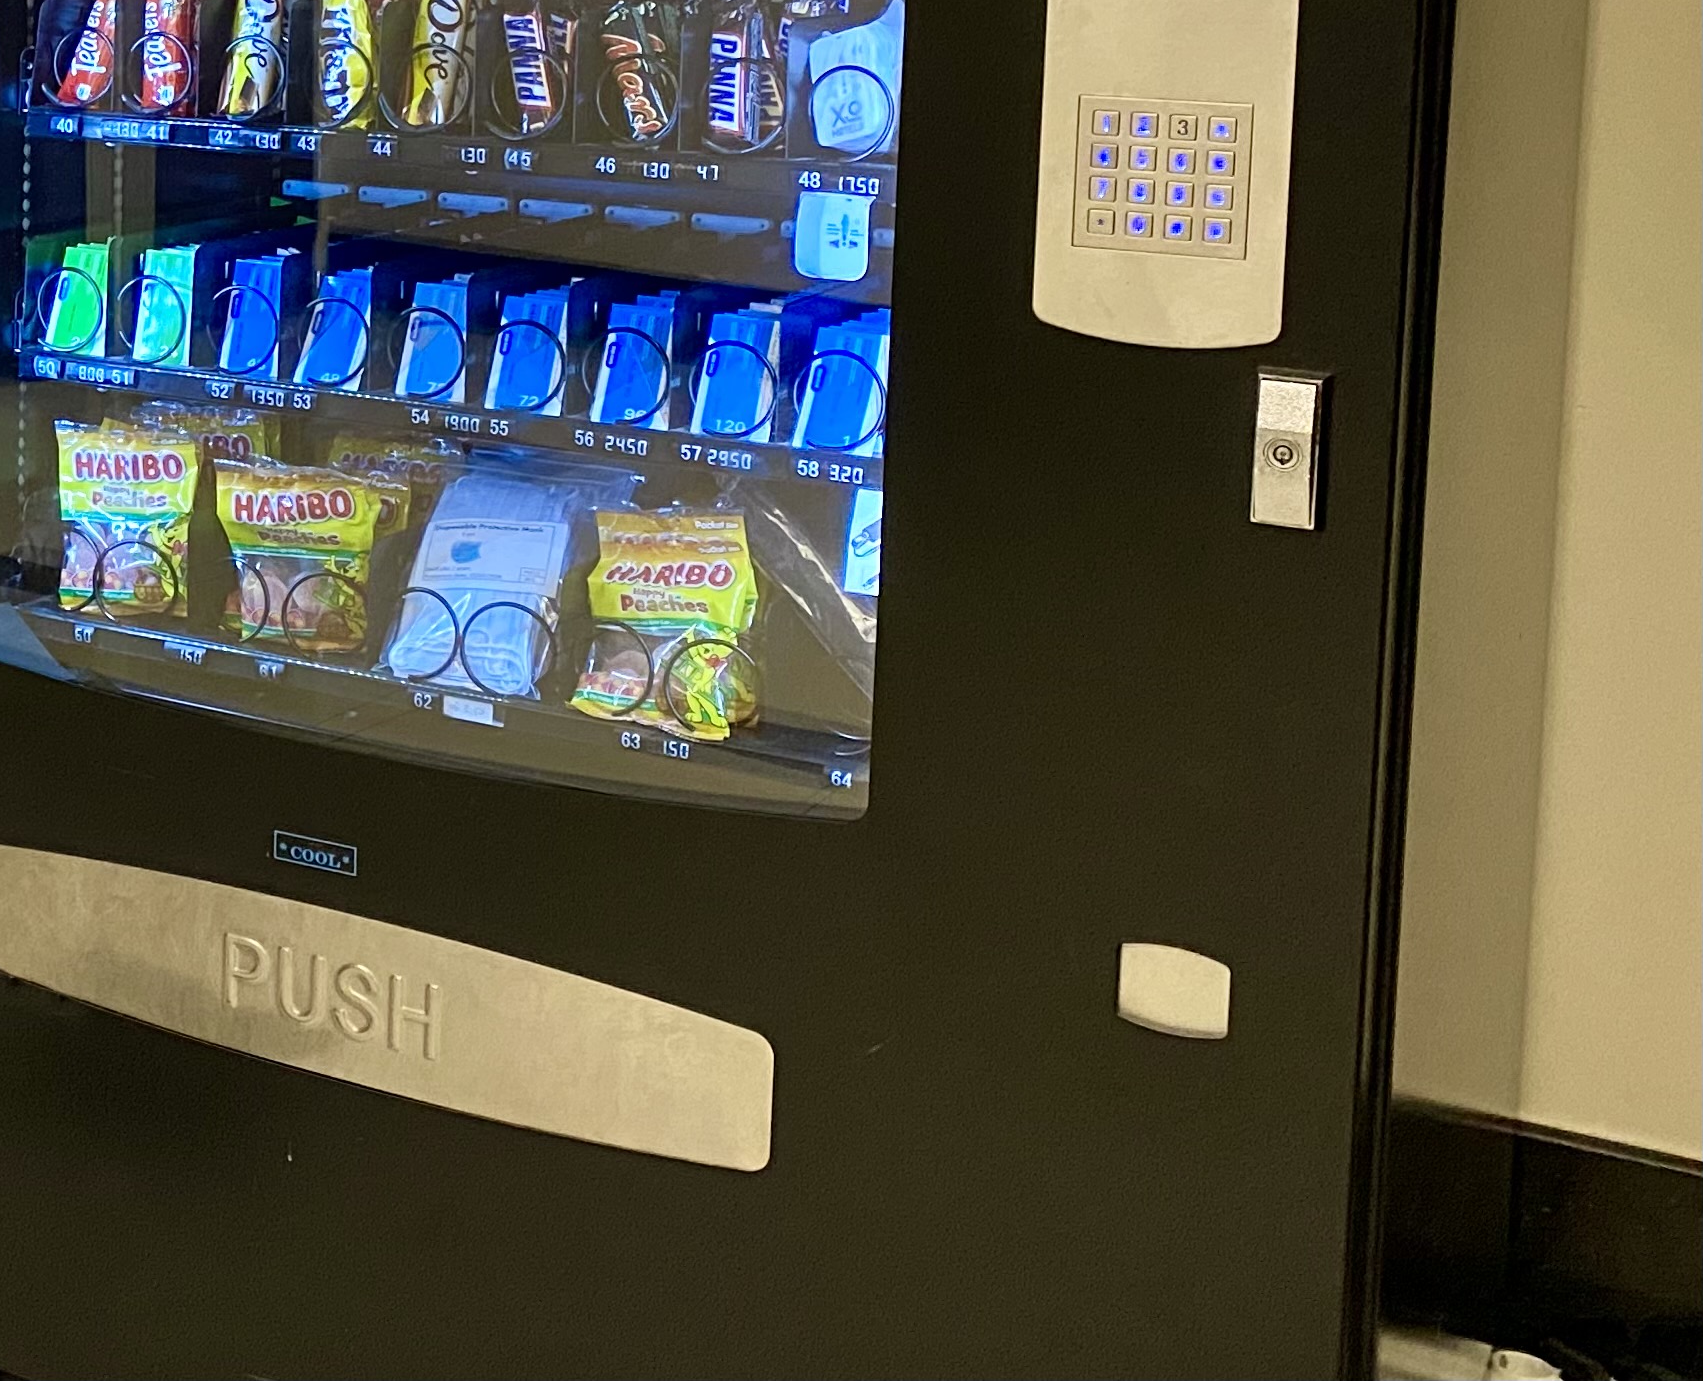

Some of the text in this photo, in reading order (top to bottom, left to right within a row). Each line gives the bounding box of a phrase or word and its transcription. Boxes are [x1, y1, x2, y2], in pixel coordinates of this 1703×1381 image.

[710, 35, 739, 131] PANNA
[1177, 120, 1189, 135] 3
[57, 120, 73, 133] 40
[146, 125, 164, 140] 41
[214, 130, 233, 145] 42
[297, 136, 315, 151] 43
[373, 141, 391, 156] 44
[507, 151, 532, 167] 45
[596, 157, 616, 173] 46
[799, 171, 821, 188] 48
[38, 361, 55, 375] 50
[112, 369, 129, 383] 51
[211, 384, 228, 398] 52
[294, 394, 311, 409] 53
[411, 410, 429, 424] 54
[490, 419, 508, 436] 55
[575, 430, 594, 448] 56
[681, 444, 700, 462] 57
[797, 460, 819, 478] 58
[714, 420, 746, 433] 120
[74, 452, 183, 480] HARIBO
[234, 490, 352, 522] HARIBO
[605, 561, 733, 588] HARIBO
[621, 595, 708, 614] Peaches
[74, 628, 91, 643] 60
[414, 693, 432, 709] 62
[621, 732, 640, 749] 63
[831, 771, 852, 787] 64
[290, 844, 342, 869] COOL
[225, 932, 439, 1060] PUSH
